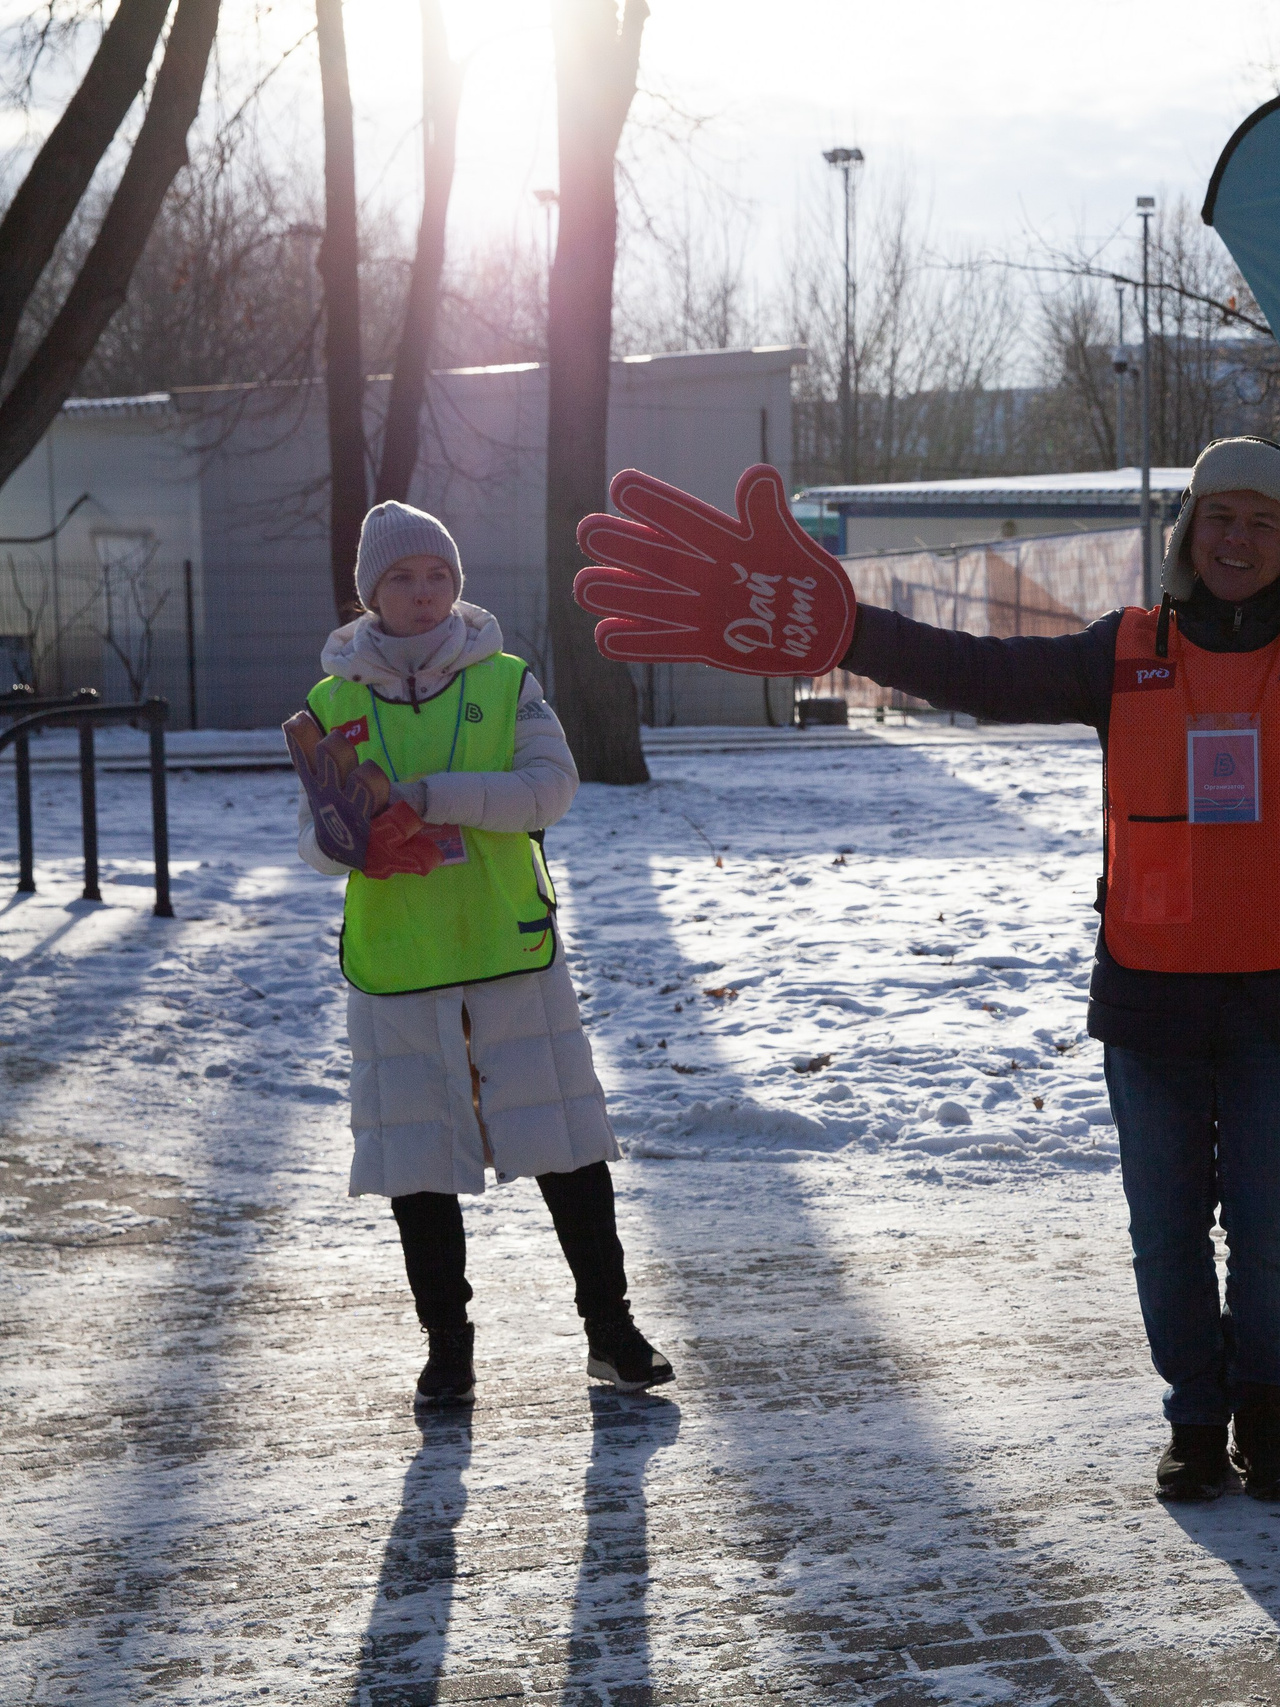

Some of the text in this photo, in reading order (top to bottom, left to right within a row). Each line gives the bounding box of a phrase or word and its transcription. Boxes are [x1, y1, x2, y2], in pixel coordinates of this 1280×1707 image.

[723, 562, 783, 654] Дай
[781, 575, 818, 658] пять
[1203, 783, 1246, 792] Организатор
